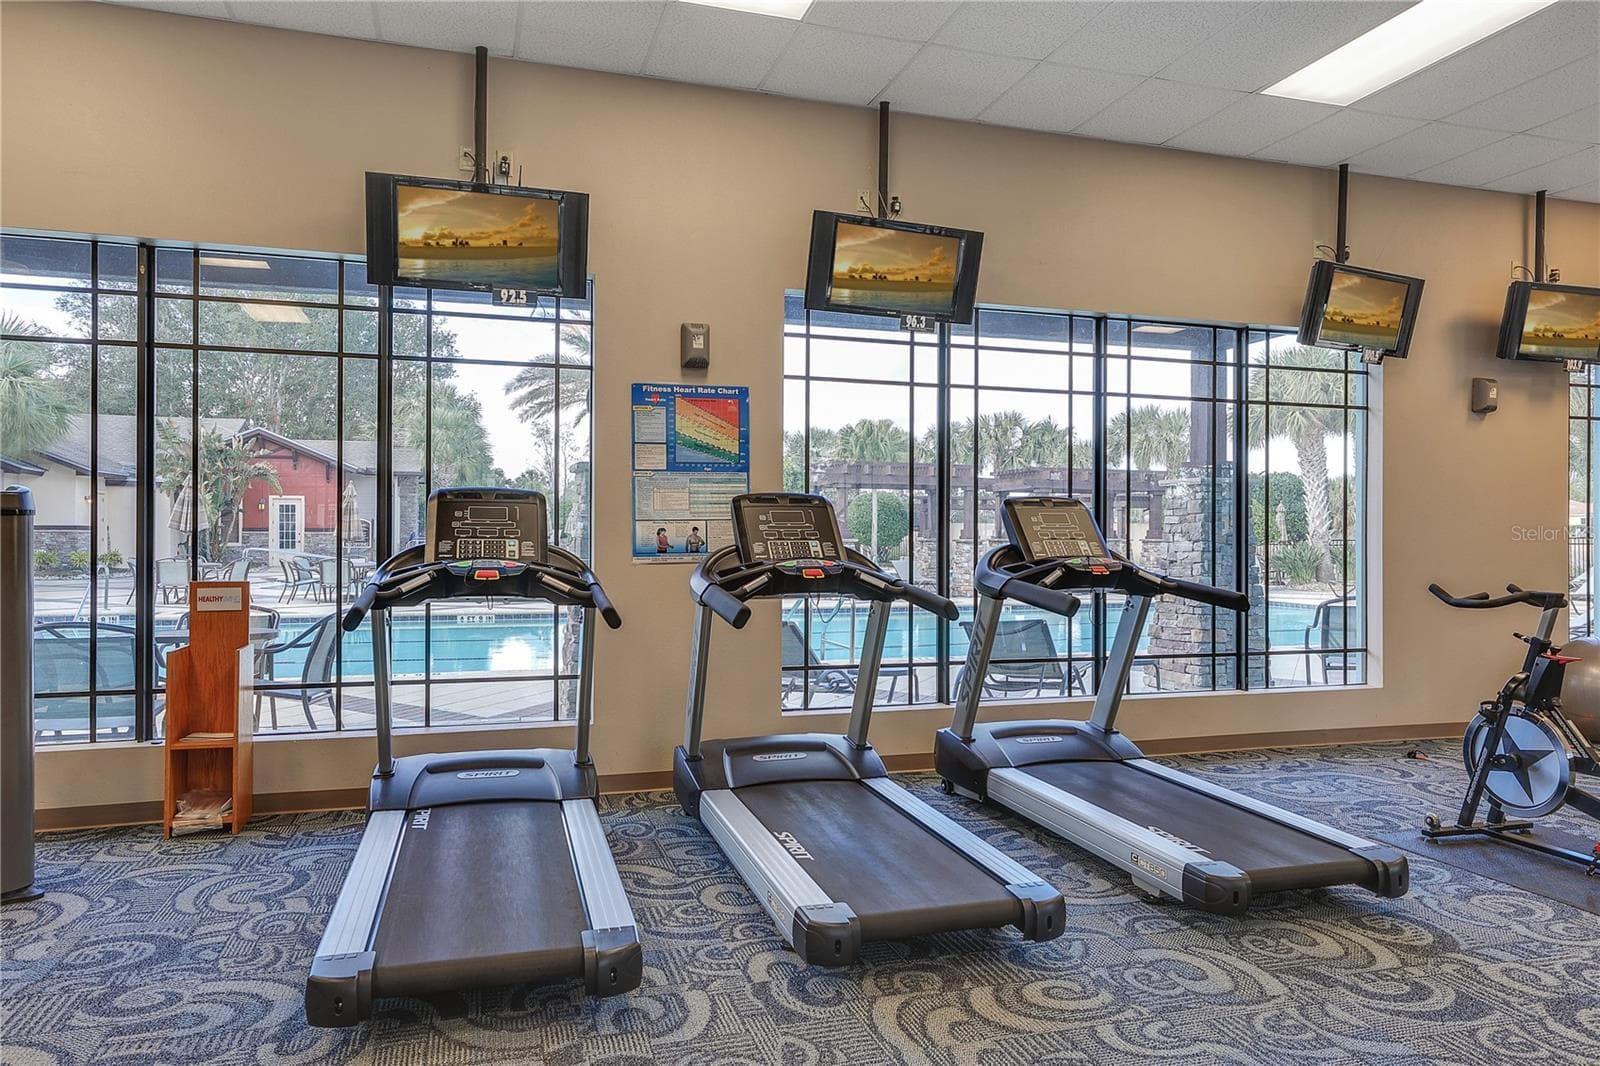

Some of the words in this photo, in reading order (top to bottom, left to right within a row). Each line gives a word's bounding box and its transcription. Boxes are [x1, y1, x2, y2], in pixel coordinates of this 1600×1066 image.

[500, 288, 527, 304] 92.5
[906, 315, 926, 329] 96.3
[643, 385, 672, 393] Fitness
[717, 387, 739, 395] Chart
[198, 595, 223, 603] HEALTHY
[962, 620, 986, 710] SPIRIT
[465, 769, 511, 777] SPIRIT
[411, 808, 432, 830] PIRIT
[773, 831, 816, 861] SPIRIT
